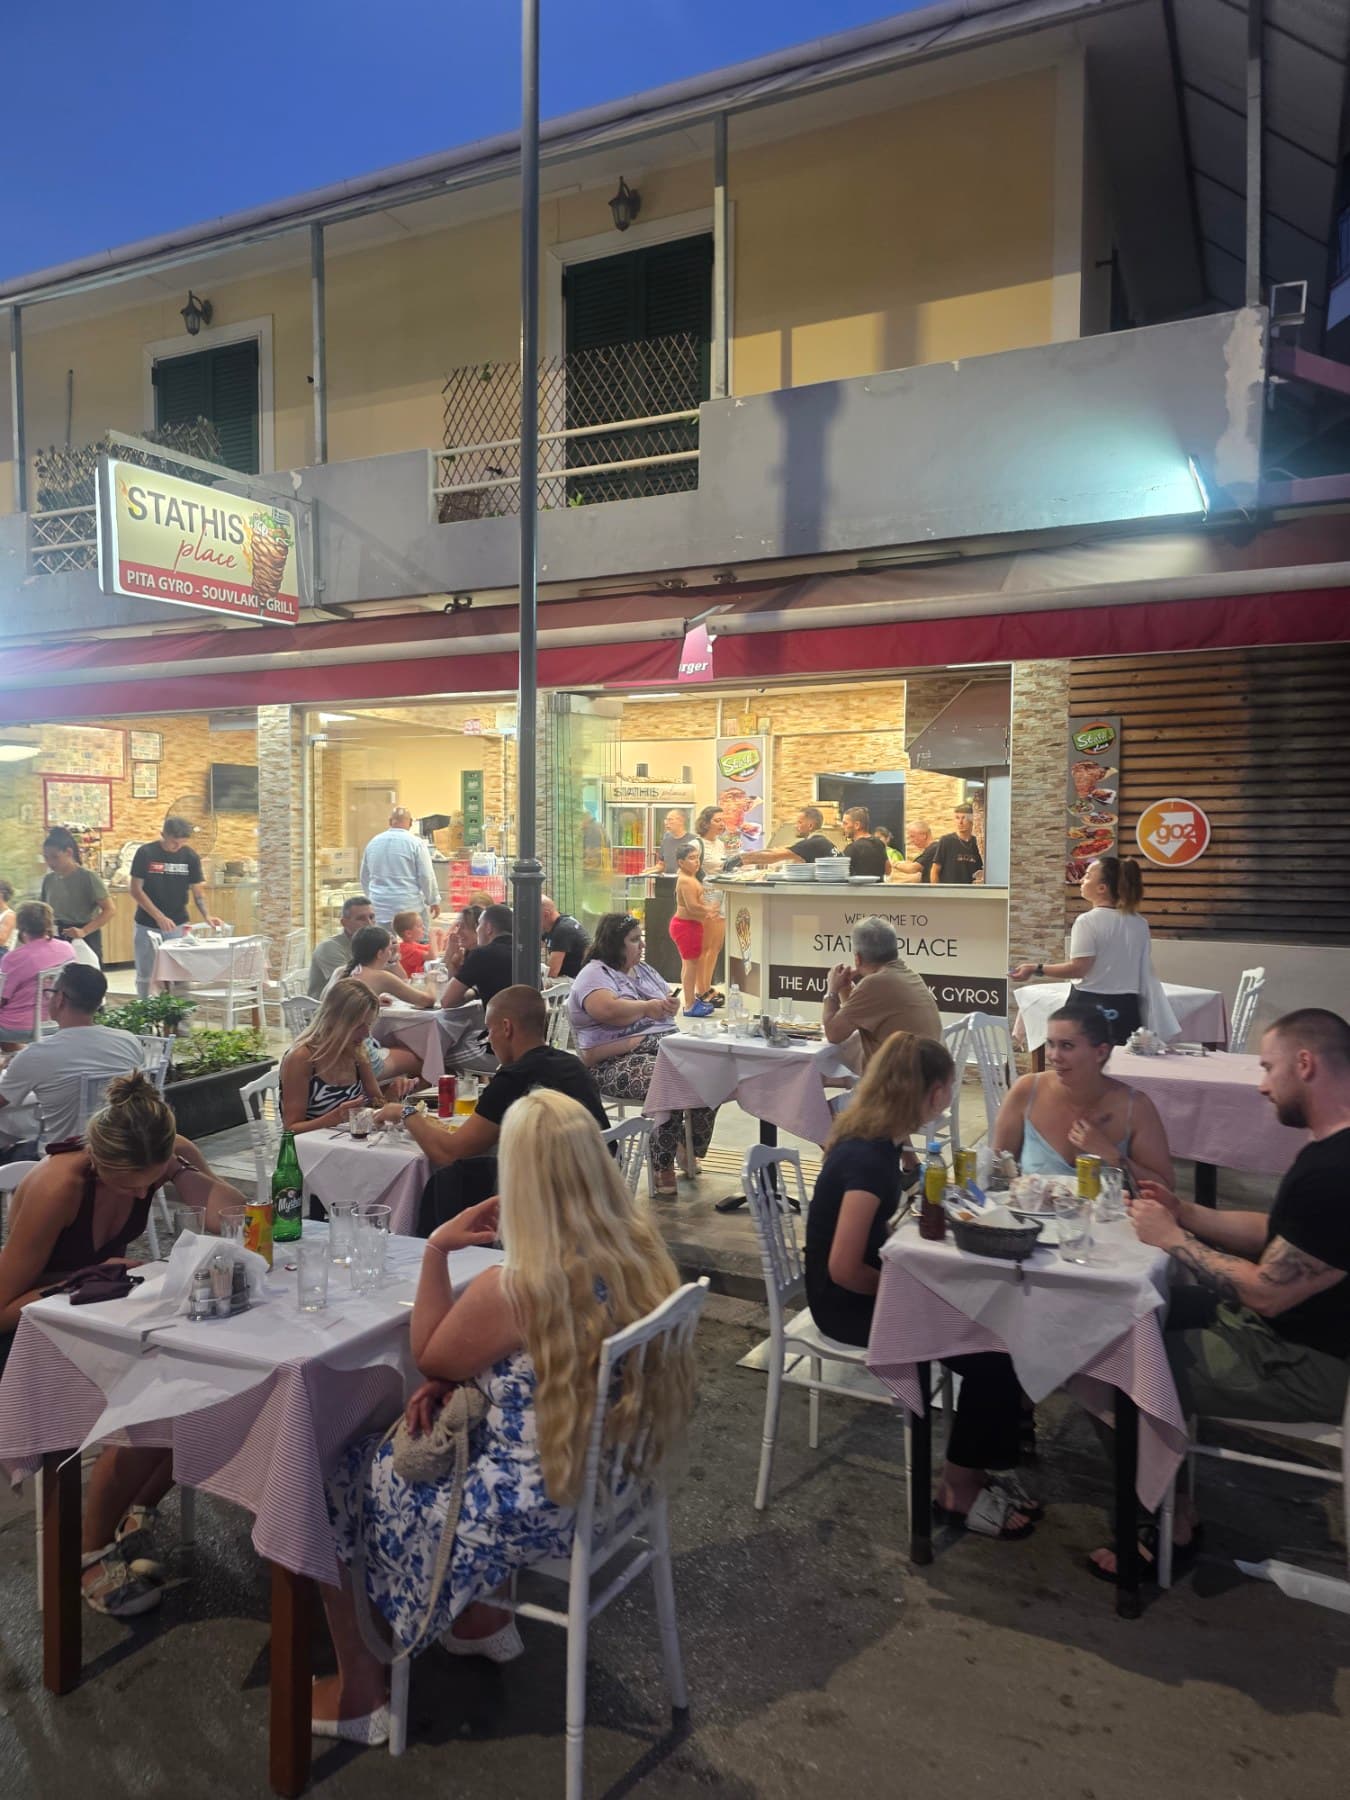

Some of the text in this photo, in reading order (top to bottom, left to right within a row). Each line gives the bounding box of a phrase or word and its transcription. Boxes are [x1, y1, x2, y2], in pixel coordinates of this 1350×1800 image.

[127, 486, 245, 545] STATHIS
[173, 527, 238, 574] place
[127, 569, 156, 589] PITA
[158, 576, 193, 596] GYRO
[202, 585, 259, 608] SOUVLAKI
[266, 598, 296, 616] GRILL
[679, 662, 708, 675] rger
[910, 914, 929, 927] TO
[779, 975, 803, 991] THE
[941, 986, 1000, 1005] GYROS
